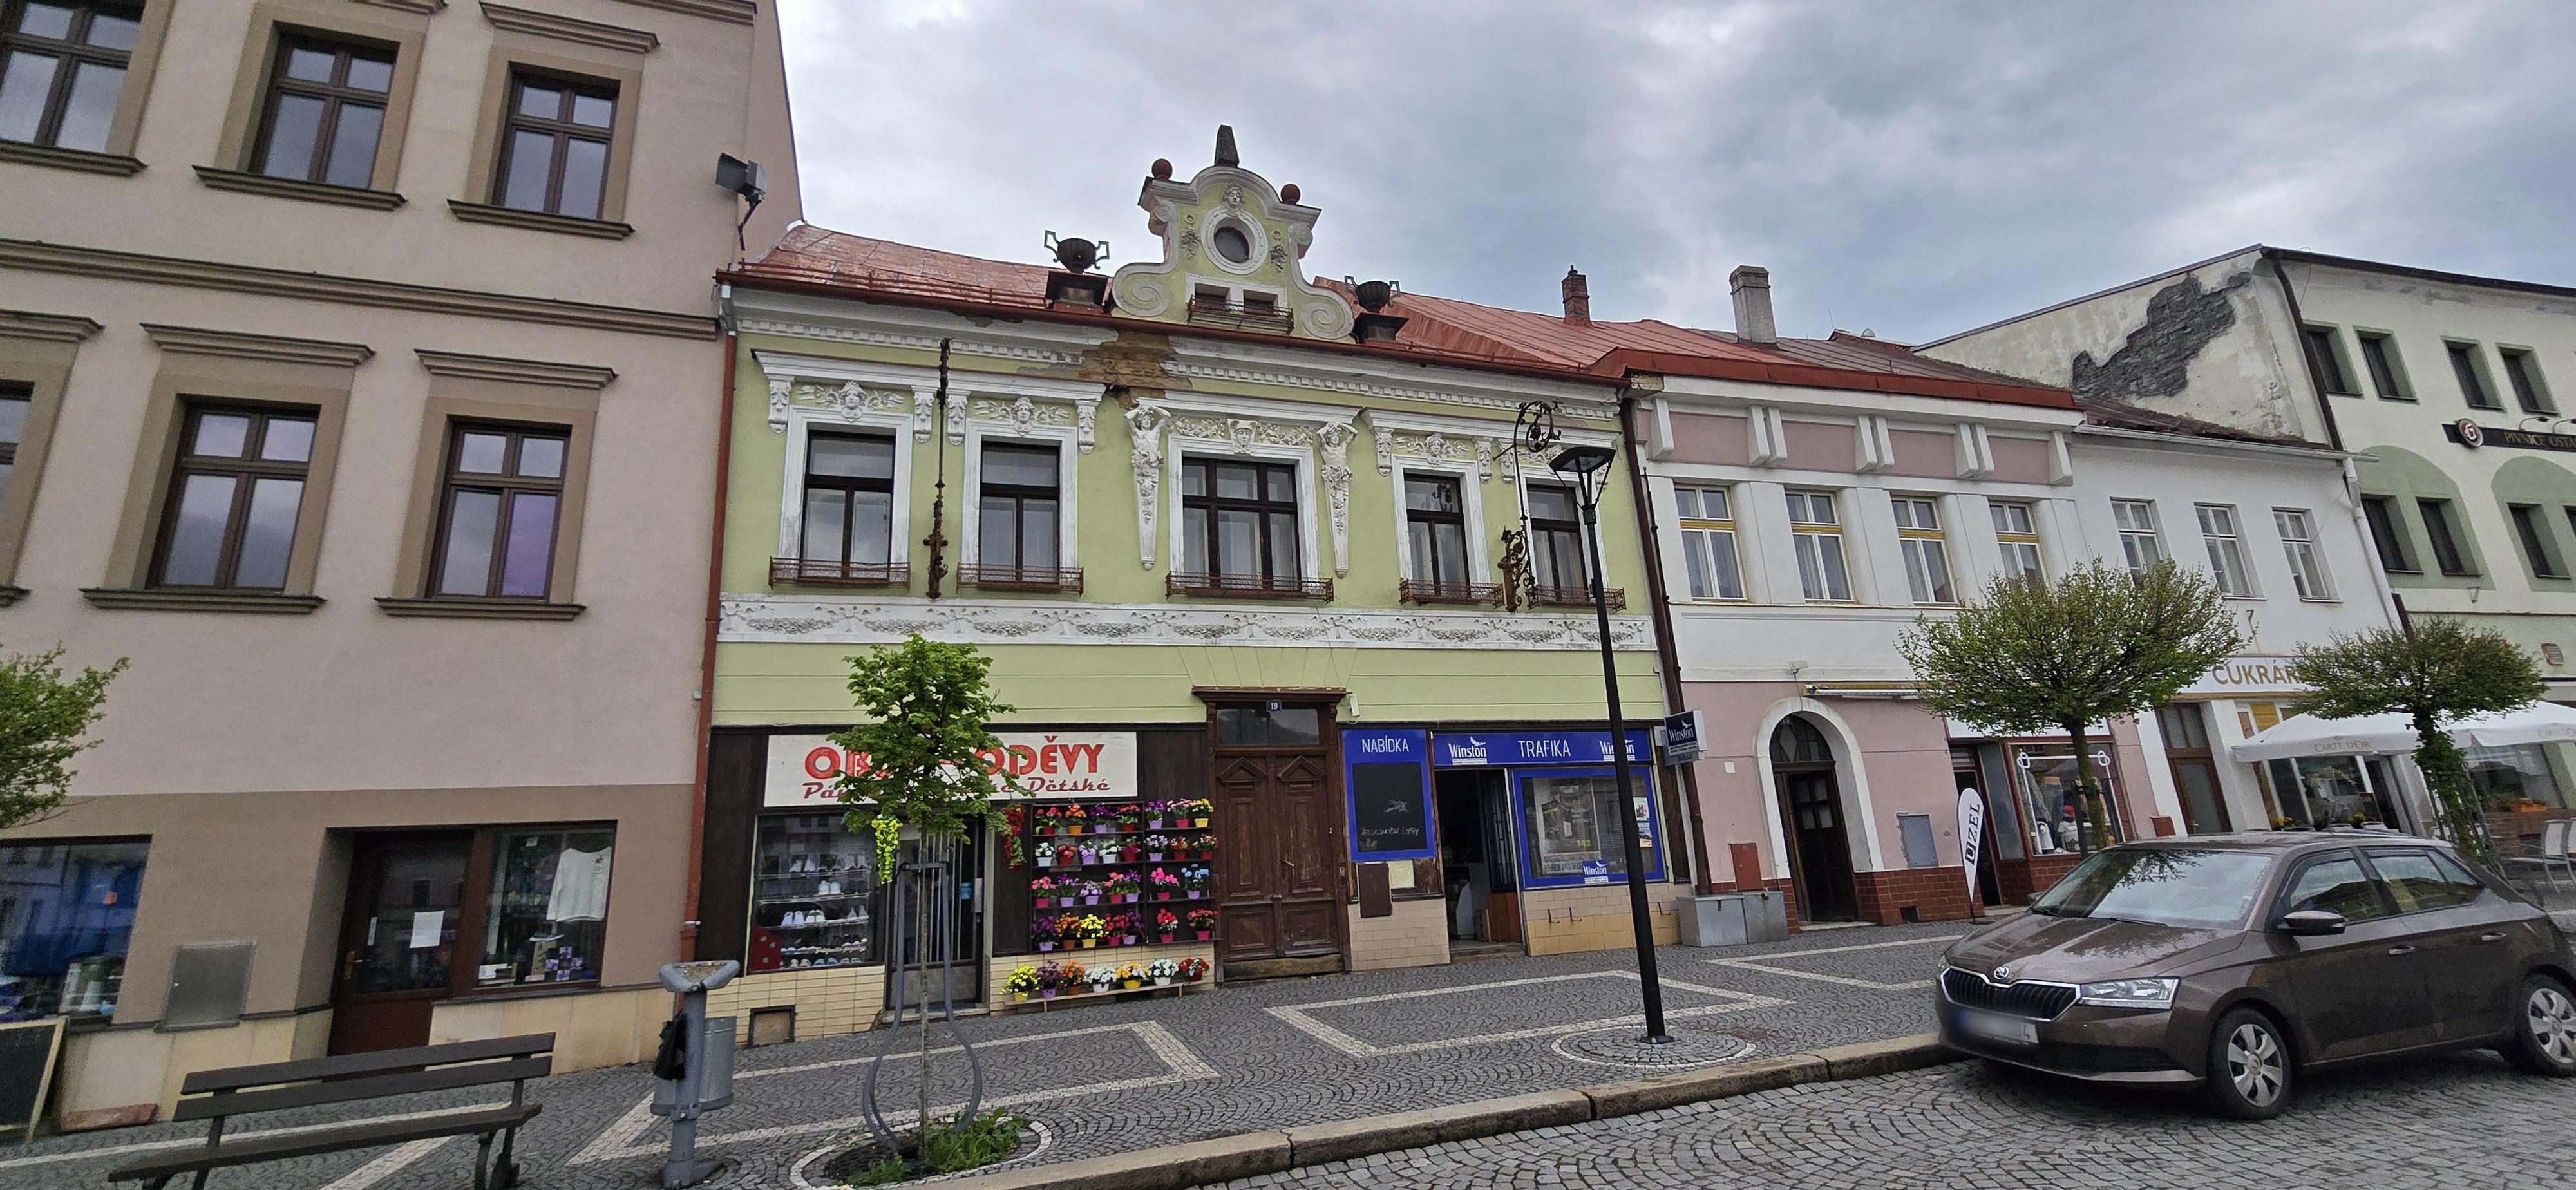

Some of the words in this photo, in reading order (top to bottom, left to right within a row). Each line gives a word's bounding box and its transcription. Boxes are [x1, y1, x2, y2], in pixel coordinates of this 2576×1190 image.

[2503, 431, 2546, 446] PIVNICE
[2212, 659, 2306, 685] CUKRÁR
[1270, 702, 1278, 710] 19
[1668, 727, 1694, 742] Winston
[1361, 735, 1410, 753] NABÍDKA
[1448, 743, 1487, 758] Winston
[1517, 739, 1571, 758] TRAFIKA
[1599, 741, 1635, 755] Wion
[804, 746, 887, 780] OB
[974, 735, 1105, 775] ODĚVY
[1964, 804, 1980, 865] UZEL
[1582, 865, 1607, 876] Winston
